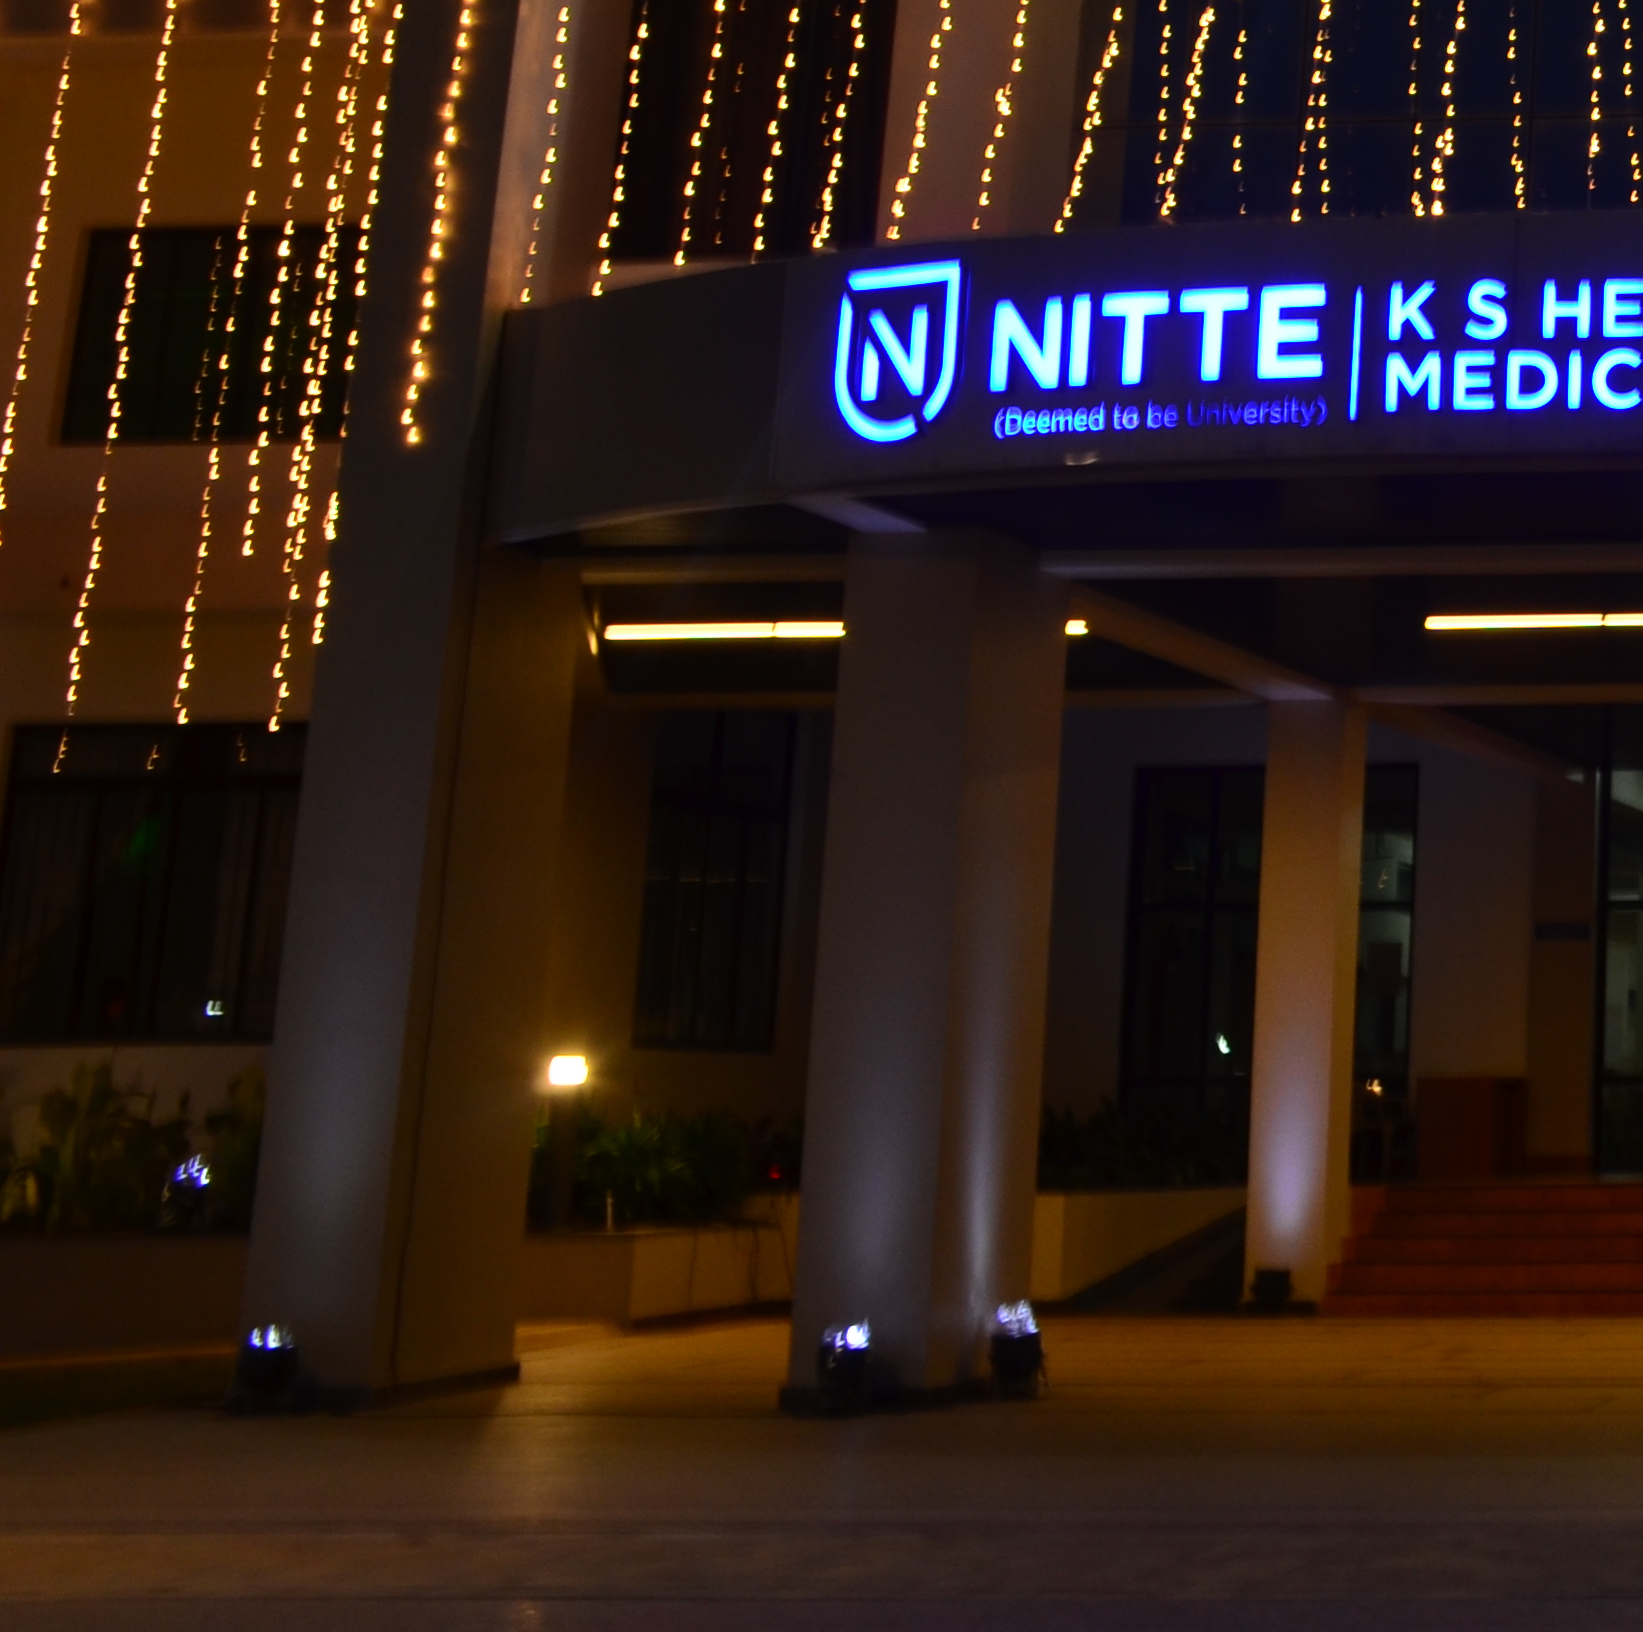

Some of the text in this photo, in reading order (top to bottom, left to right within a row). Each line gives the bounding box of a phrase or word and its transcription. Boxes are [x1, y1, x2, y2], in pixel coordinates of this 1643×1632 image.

[987, 282, 1329, 393] NITTE
[1386, 280, 1437, 342] K
[1463, 278, 1510, 342] S
[993, 401, 1106, 439] (Deemed
[1112, 402, 1141, 431] to
[1146, 399, 1179, 430] be
